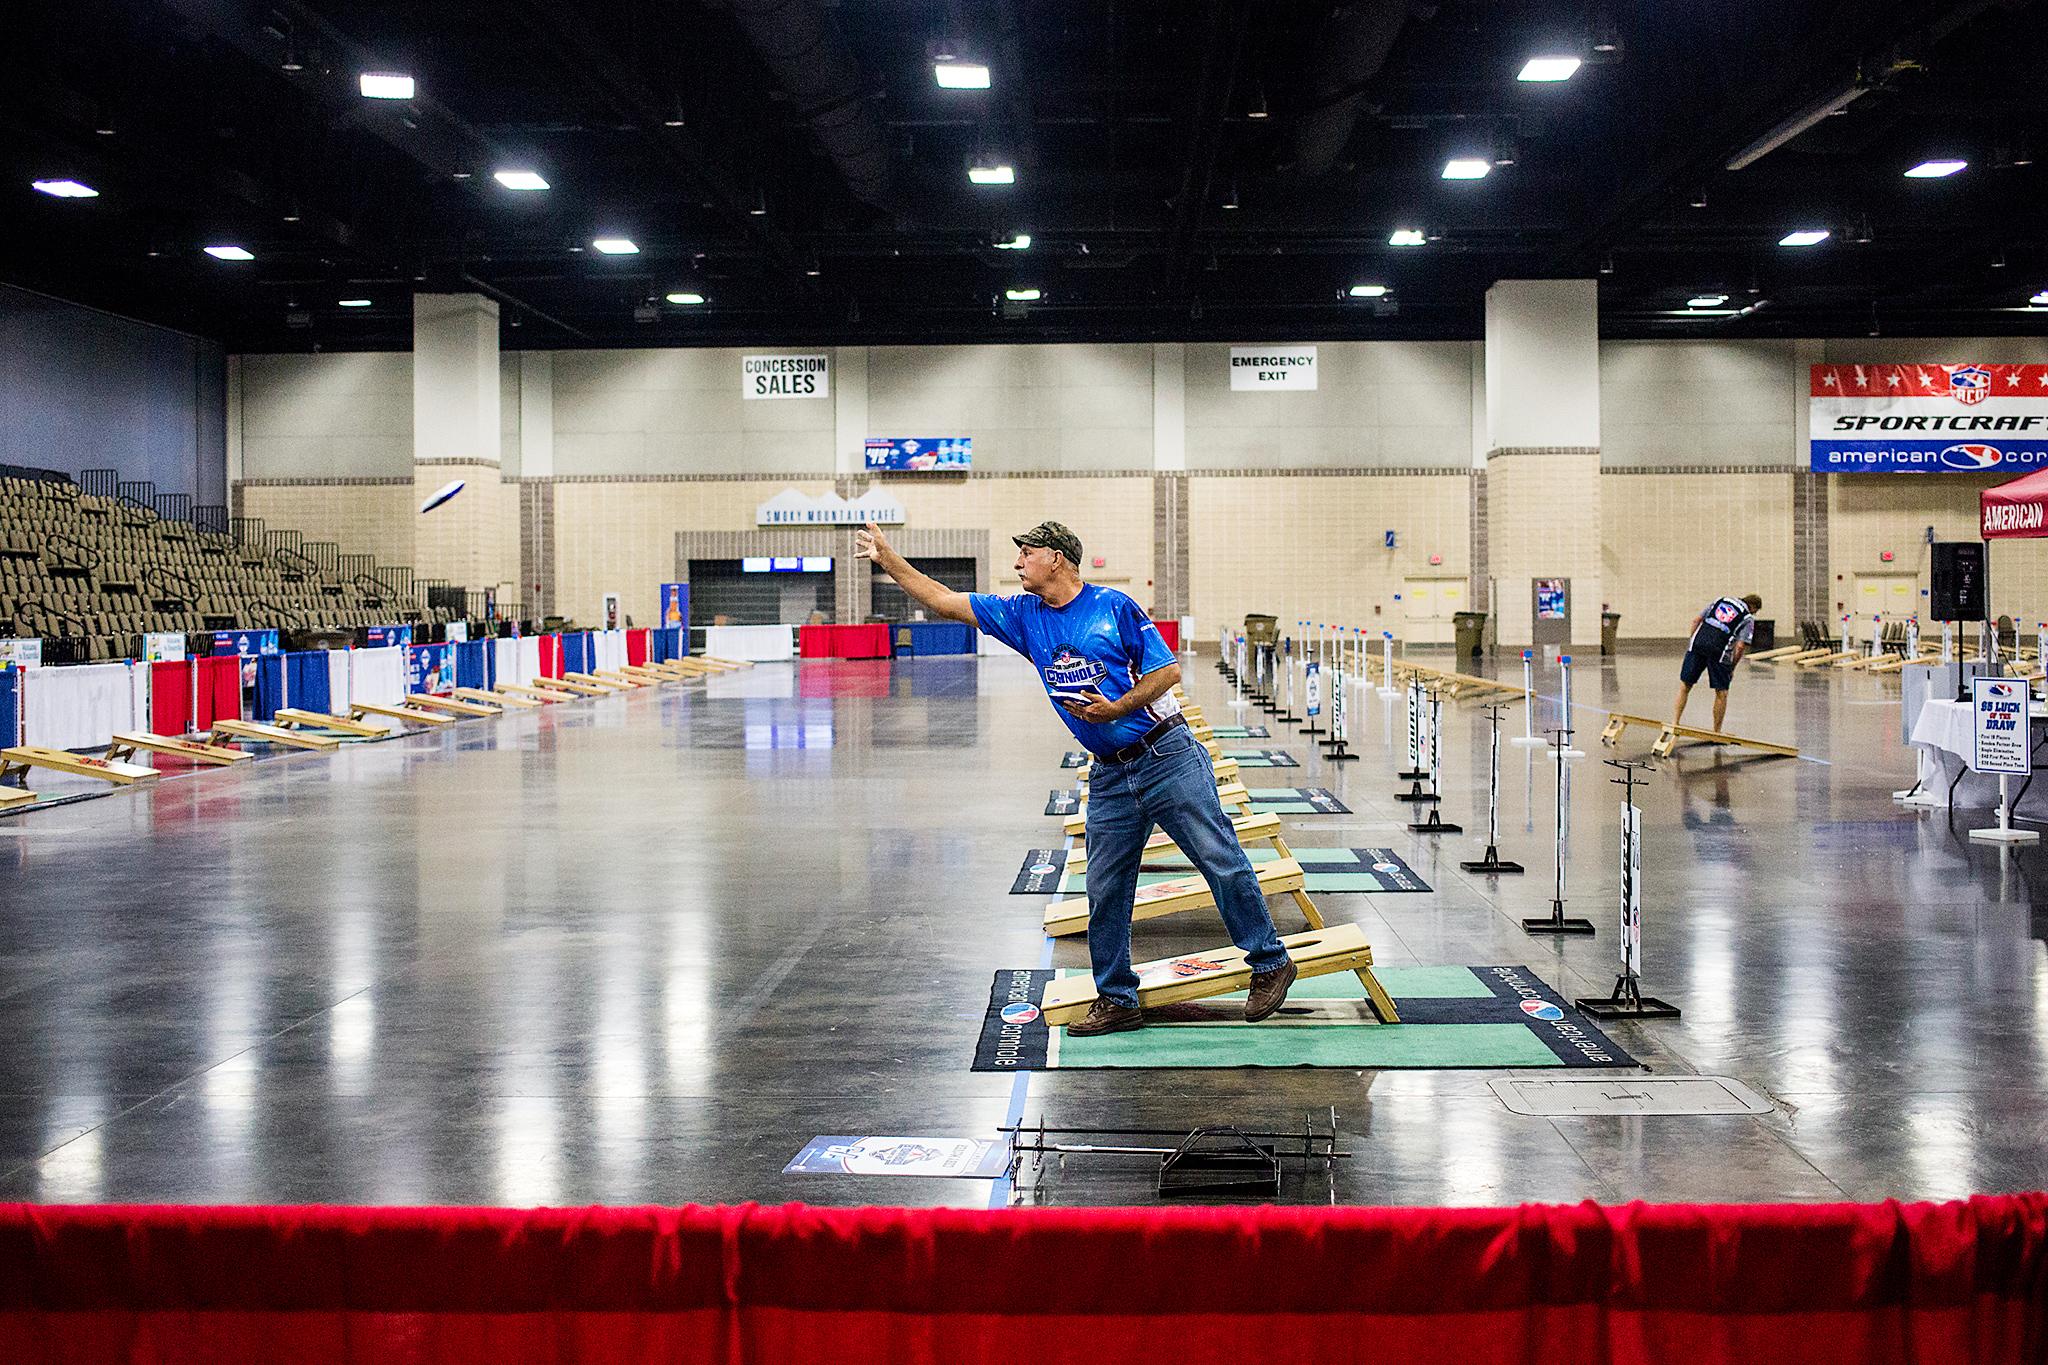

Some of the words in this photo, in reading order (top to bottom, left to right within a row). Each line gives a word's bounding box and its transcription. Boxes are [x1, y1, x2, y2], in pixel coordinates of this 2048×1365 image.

[745, 358, 826, 374] CONCESSION
[1232, 356, 1314, 367] EMERGENCY
[1259, 371, 1287, 381] EXIT
[756, 374, 815, 395] SALES
[1833, 416, 2048, 431] SPORTCRAF
[1828, 448, 1938, 463] american
[766, 510, 802, 522] SMOKY
[808, 510, 865, 521] MOUNTAIN
[1984, 502, 2044, 531] AMERICAN
[1995, 701, 2021, 713] LUCK
[1986, 719, 2016, 731] DRAW
[1490, 967, 1542, 1000] cornhole
[1550, 1019, 1613, 1062] american
[994, 1024, 1026, 1066] cornhole
